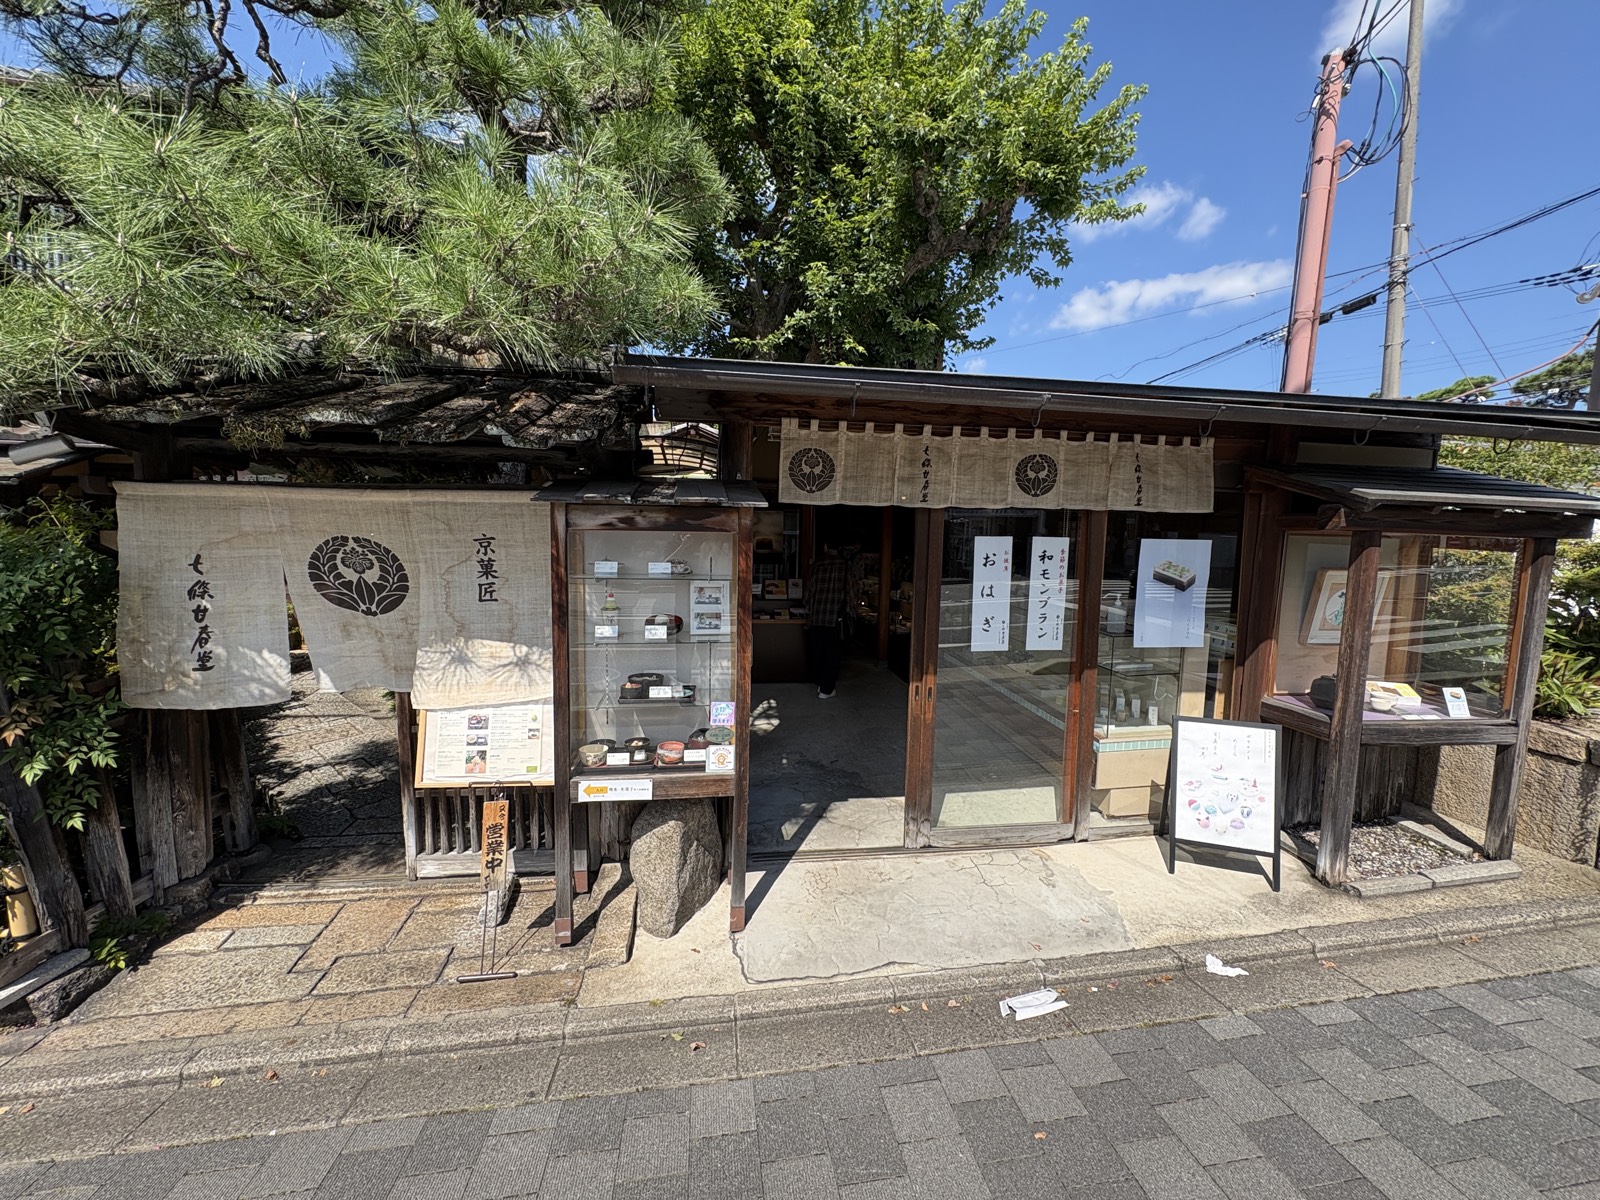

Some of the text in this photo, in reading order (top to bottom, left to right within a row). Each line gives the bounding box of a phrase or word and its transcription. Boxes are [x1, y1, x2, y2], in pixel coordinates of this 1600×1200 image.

[473, 533, 500, 603] 京菓匠
[980, 552, 997, 633] おはぎ
[1037, 549, 1054, 639] 和モンブラン
[187, 553, 216, 672] 七條甘春堂
[485, 822, 505, 875] 営業中
